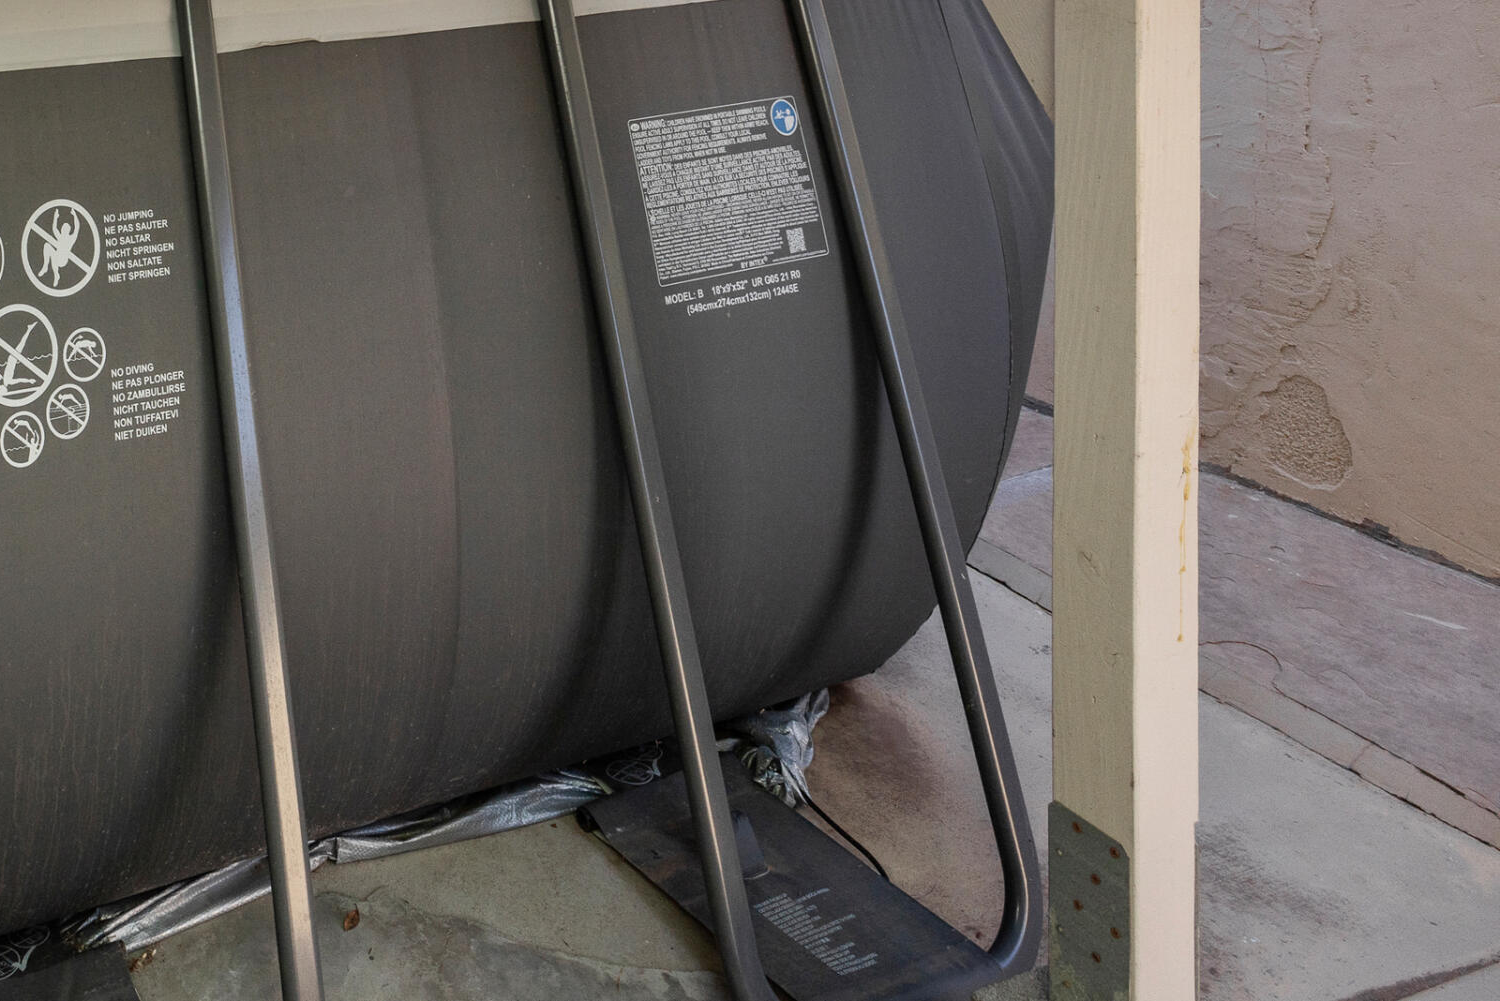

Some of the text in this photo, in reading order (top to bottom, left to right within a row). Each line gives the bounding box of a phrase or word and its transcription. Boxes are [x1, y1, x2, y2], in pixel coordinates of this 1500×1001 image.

[103, 209, 154, 223] NO JUMPING
[104, 219, 168, 235] NE PAS SAUTER
[105, 233, 151, 247] NO SALTAR
[106, 242, 174, 259] NICHT SPRINGEN
[107, 256, 163, 271] NON SALTATE
[108, 267, 171, 283] NIET SPRINGEN
[664, 291, 697, 305] MODEL:
[697, 289, 704, 299] B
[751, 277, 764, 287] UR
[780, 271, 789, 281] 21
[111, 363, 154, 378] NO DIVING
[111, 370, 185, 390] NE PAS PLONGER
[112, 382, 186, 403] NO ZAMBULLIRSE
[113, 396, 180, 416] NICHT TAUCHEN
[114, 409, 179, 429] NON TUFFATEVI
[114, 424, 168, 441] NIET DUIKEN
